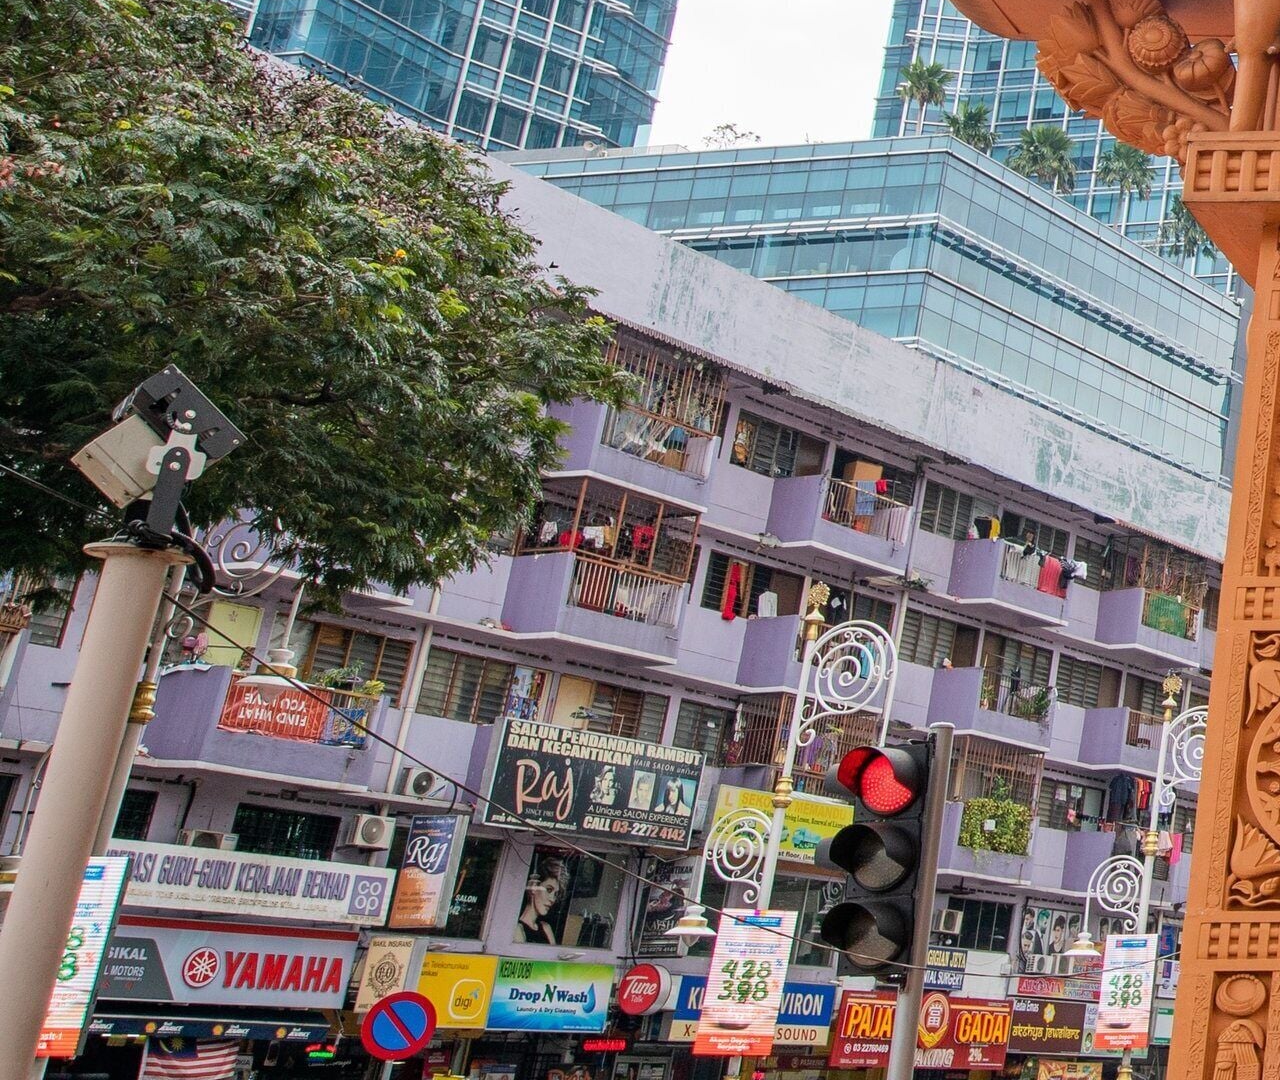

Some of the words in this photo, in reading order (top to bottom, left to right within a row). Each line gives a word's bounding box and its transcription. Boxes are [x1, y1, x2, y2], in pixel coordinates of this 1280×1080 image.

[238, 707, 272, 722] WHAT
[281, 698, 306, 712] YOU
[276, 712, 307, 726] FIND
[507, 733, 540, 752] DAN
[541, 739, 632, 767] KECANTIKAN
[510, 720, 560, 740] SALUN
[561, 730, 645, 756] PENDANDAN
[646, 744, 702, 766] RAMBUT
[633, 759, 651, 768] HAIR
[652, 761, 675, 772] SALON
[516, 758, 573, 821] Raj
[595, 806, 622, 817] Unique
[623, 809, 648, 820] SALON
[648, 812, 689, 826] EXPERIENCE
[582, 815, 612, 832] CALL
[612, 819, 659, 838] 03-2272
[659, 826, 686, 841] 4142
[406, 834, 452, 873] Raj
[158, 854, 236, 890] GURU-GURU
[234, 862, 303, 897] KERAJAAN
[302, 870, 350, 900] BERHAD
[455, 893, 477, 903] SALON
[110, 965, 145, 977] MOTORS
[222, 951, 344, 994] YAMAHA
[499, 960, 518, 979] KEDAI
[508, 987, 541, 1003] Drop
[542, 983, 557, 1003] N
[556, 990, 588, 1003] Wash
[623, 975, 658, 999] Tune
[454, 996, 472, 1010] digi
[631, 994, 644, 1003] Talk
[516, 1006, 537, 1014] Laundry
[544, 1007, 554, 1015] Dry
[956, 1012, 1010, 1044] GADAI
